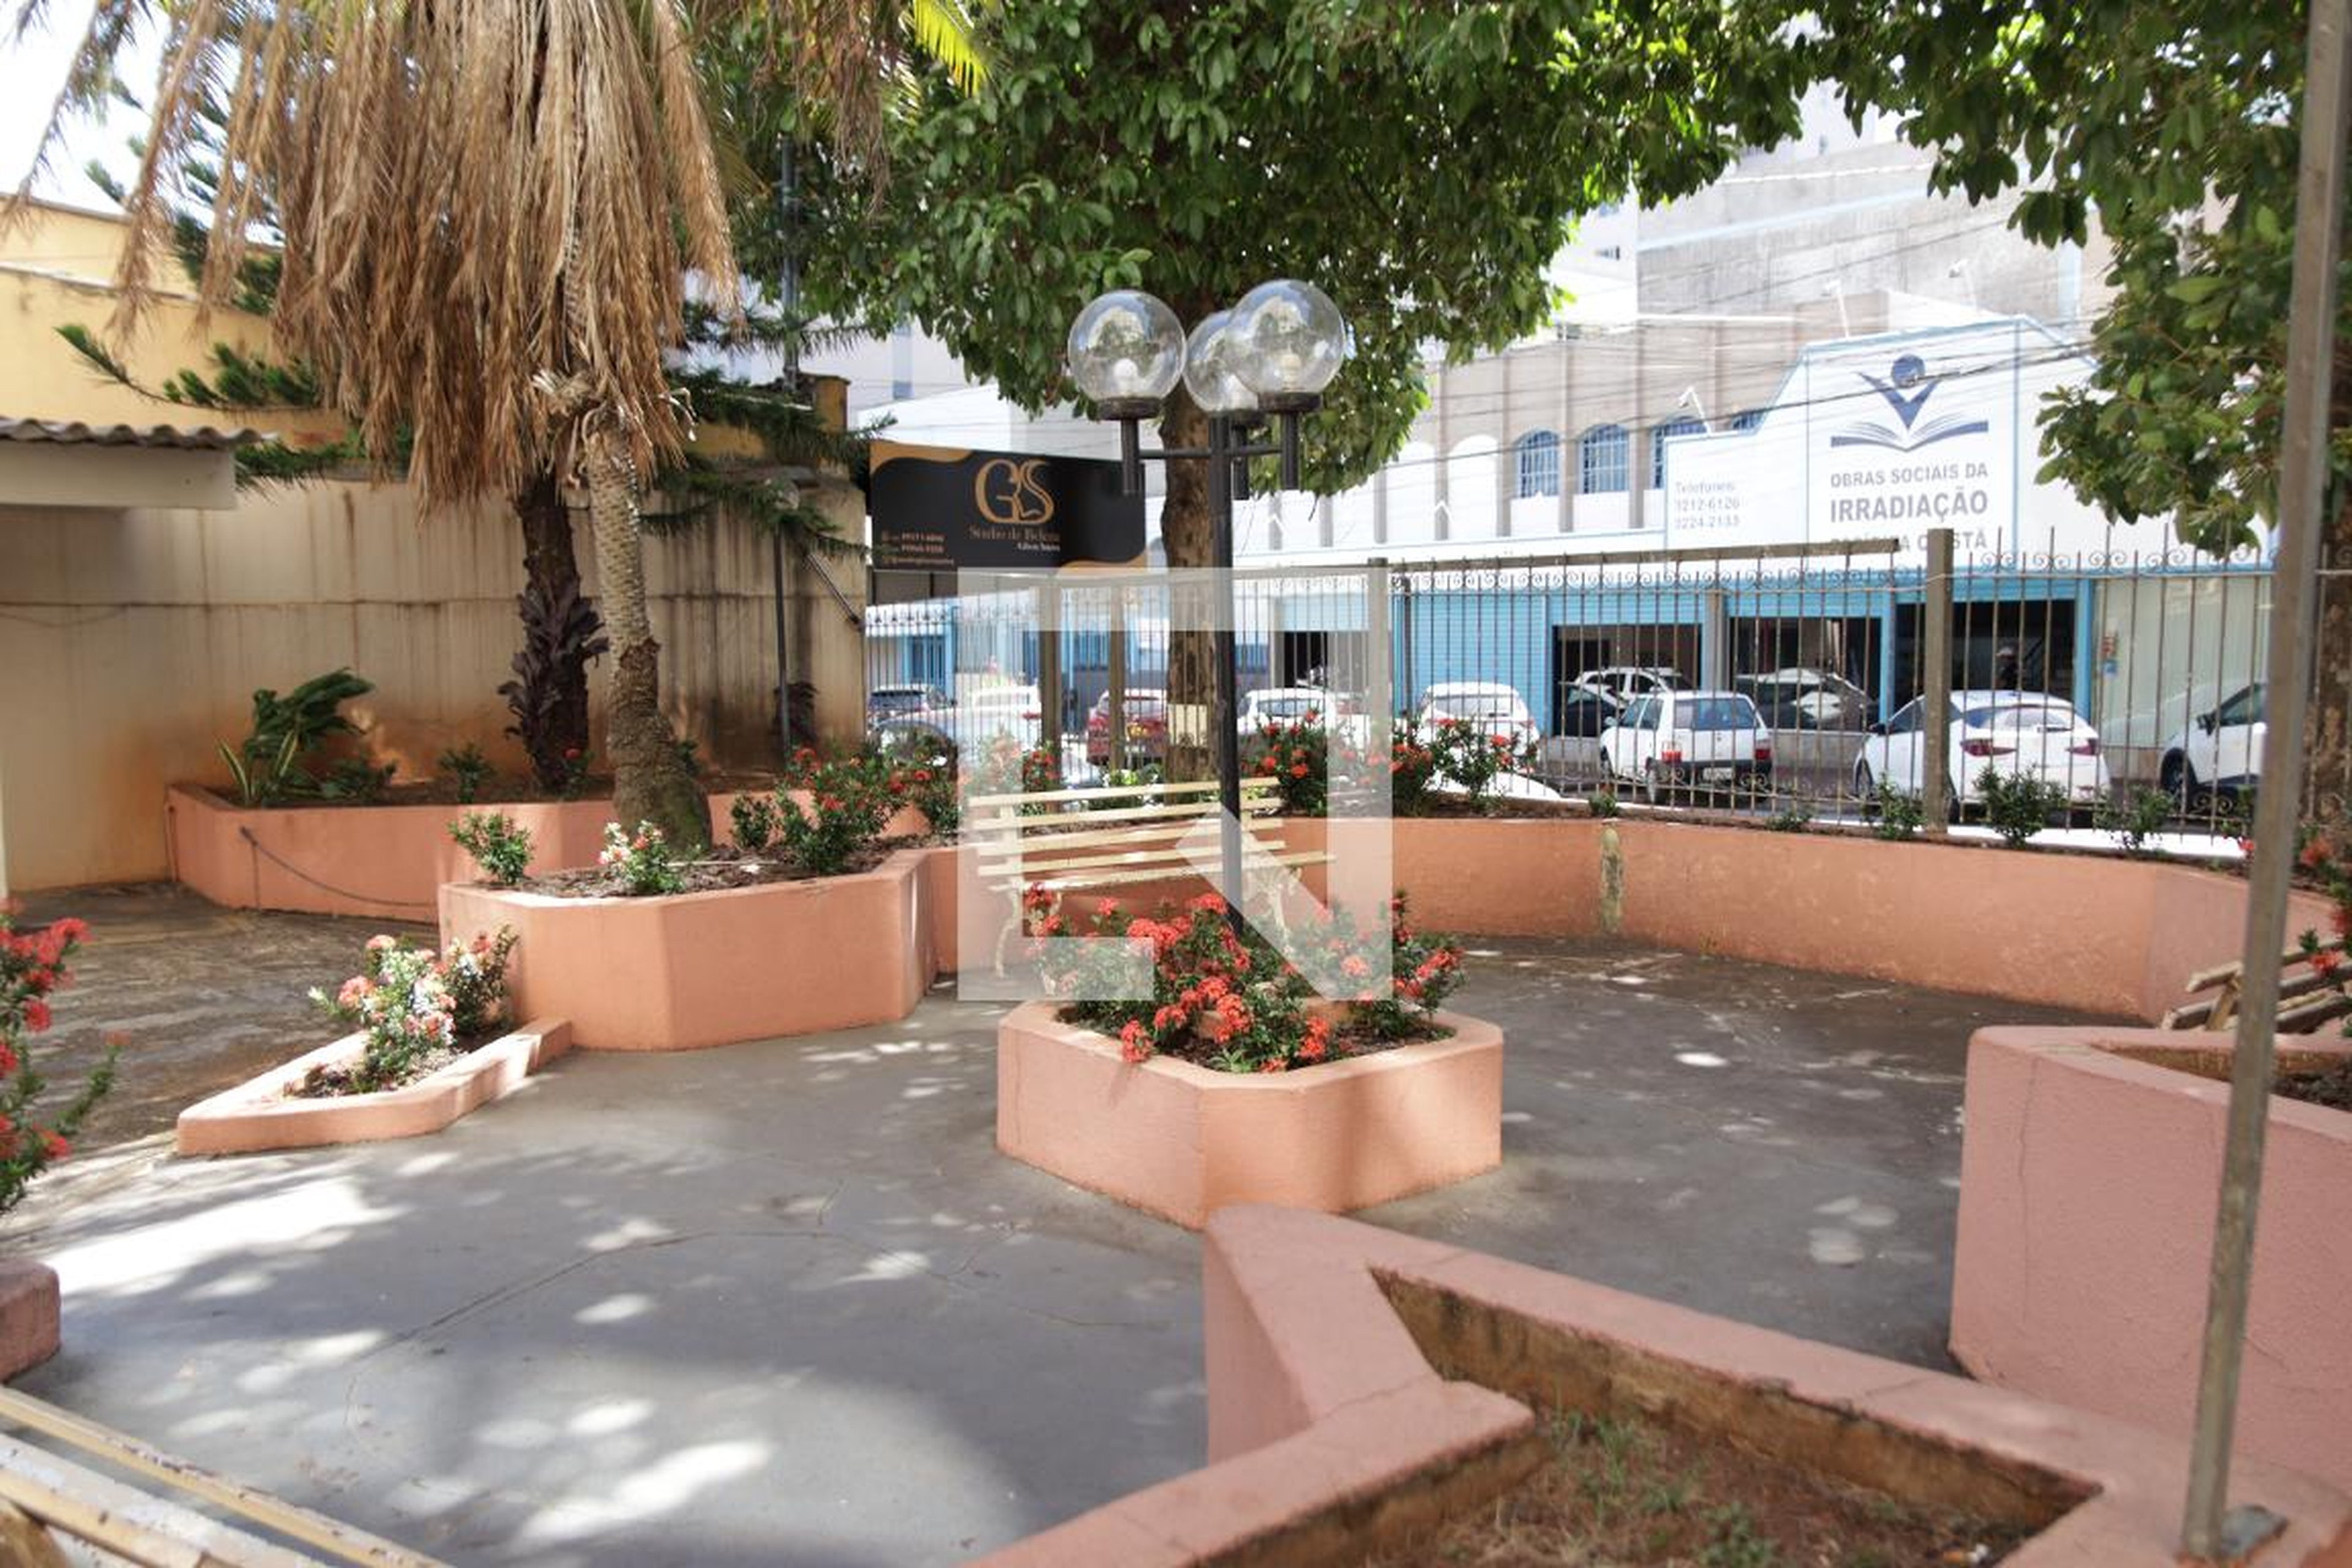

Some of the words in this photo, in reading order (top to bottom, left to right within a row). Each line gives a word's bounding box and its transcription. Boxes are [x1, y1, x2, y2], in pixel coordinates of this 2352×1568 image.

[1831, 470, 1885, 488] OBRAS
[1891, 464, 1959, 484] SOCIAIS
[1965, 462, 1988, 479] DA
[1831, 486, 1988, 522] IRRADIAÇÃO
[1917, 527, 1988, 551] CSTÃ
